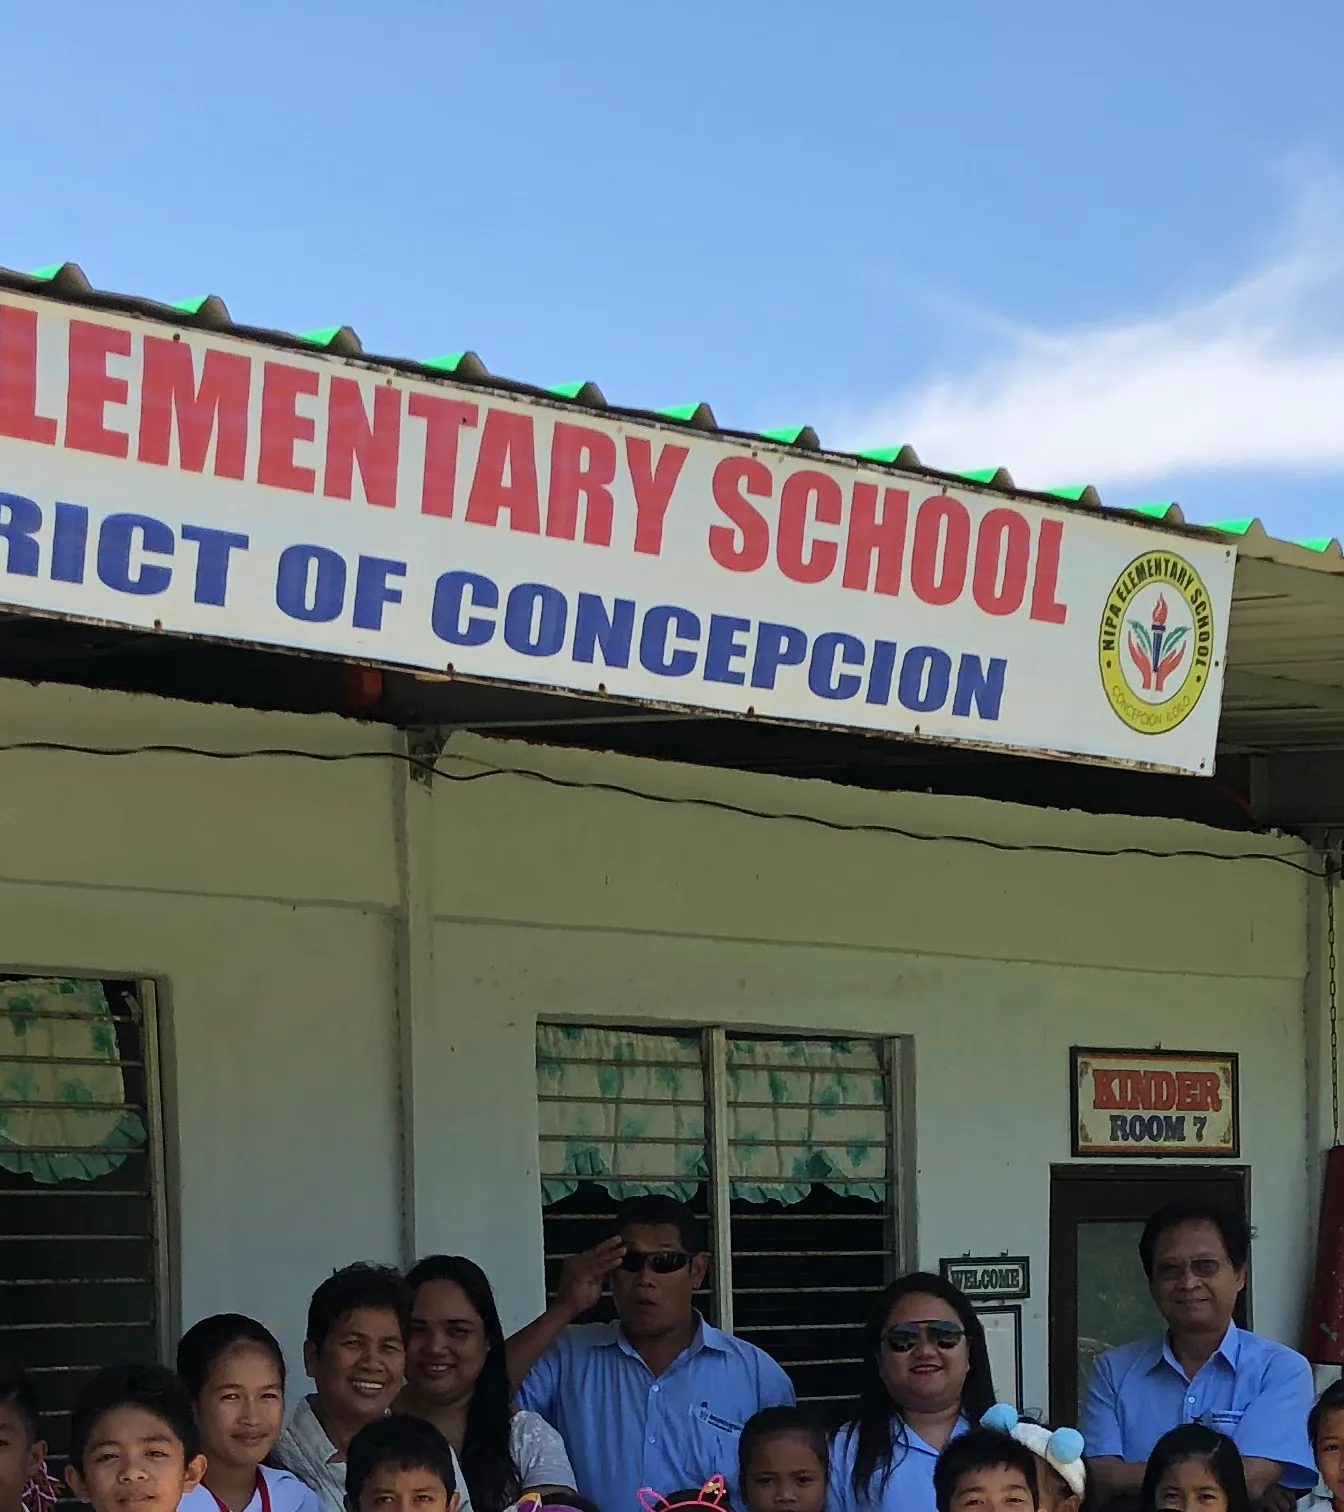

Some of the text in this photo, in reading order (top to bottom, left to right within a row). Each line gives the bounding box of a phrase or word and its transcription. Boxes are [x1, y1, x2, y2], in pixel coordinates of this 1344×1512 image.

[708, 455, 1068, 625] SCHOOL
[275, 543, 407, 632] OF
[430, 570, 1008, 721] CONCEPCION
[1102, 556, 1211, 668] NIPA ELEMENTARY SCHOOL
[1092, 1069, 1222, 1113] KINDER
[1109, 1114, 1207, 1142] ROOM 7
[951, 1268, 1020, 1290] WELCOME
